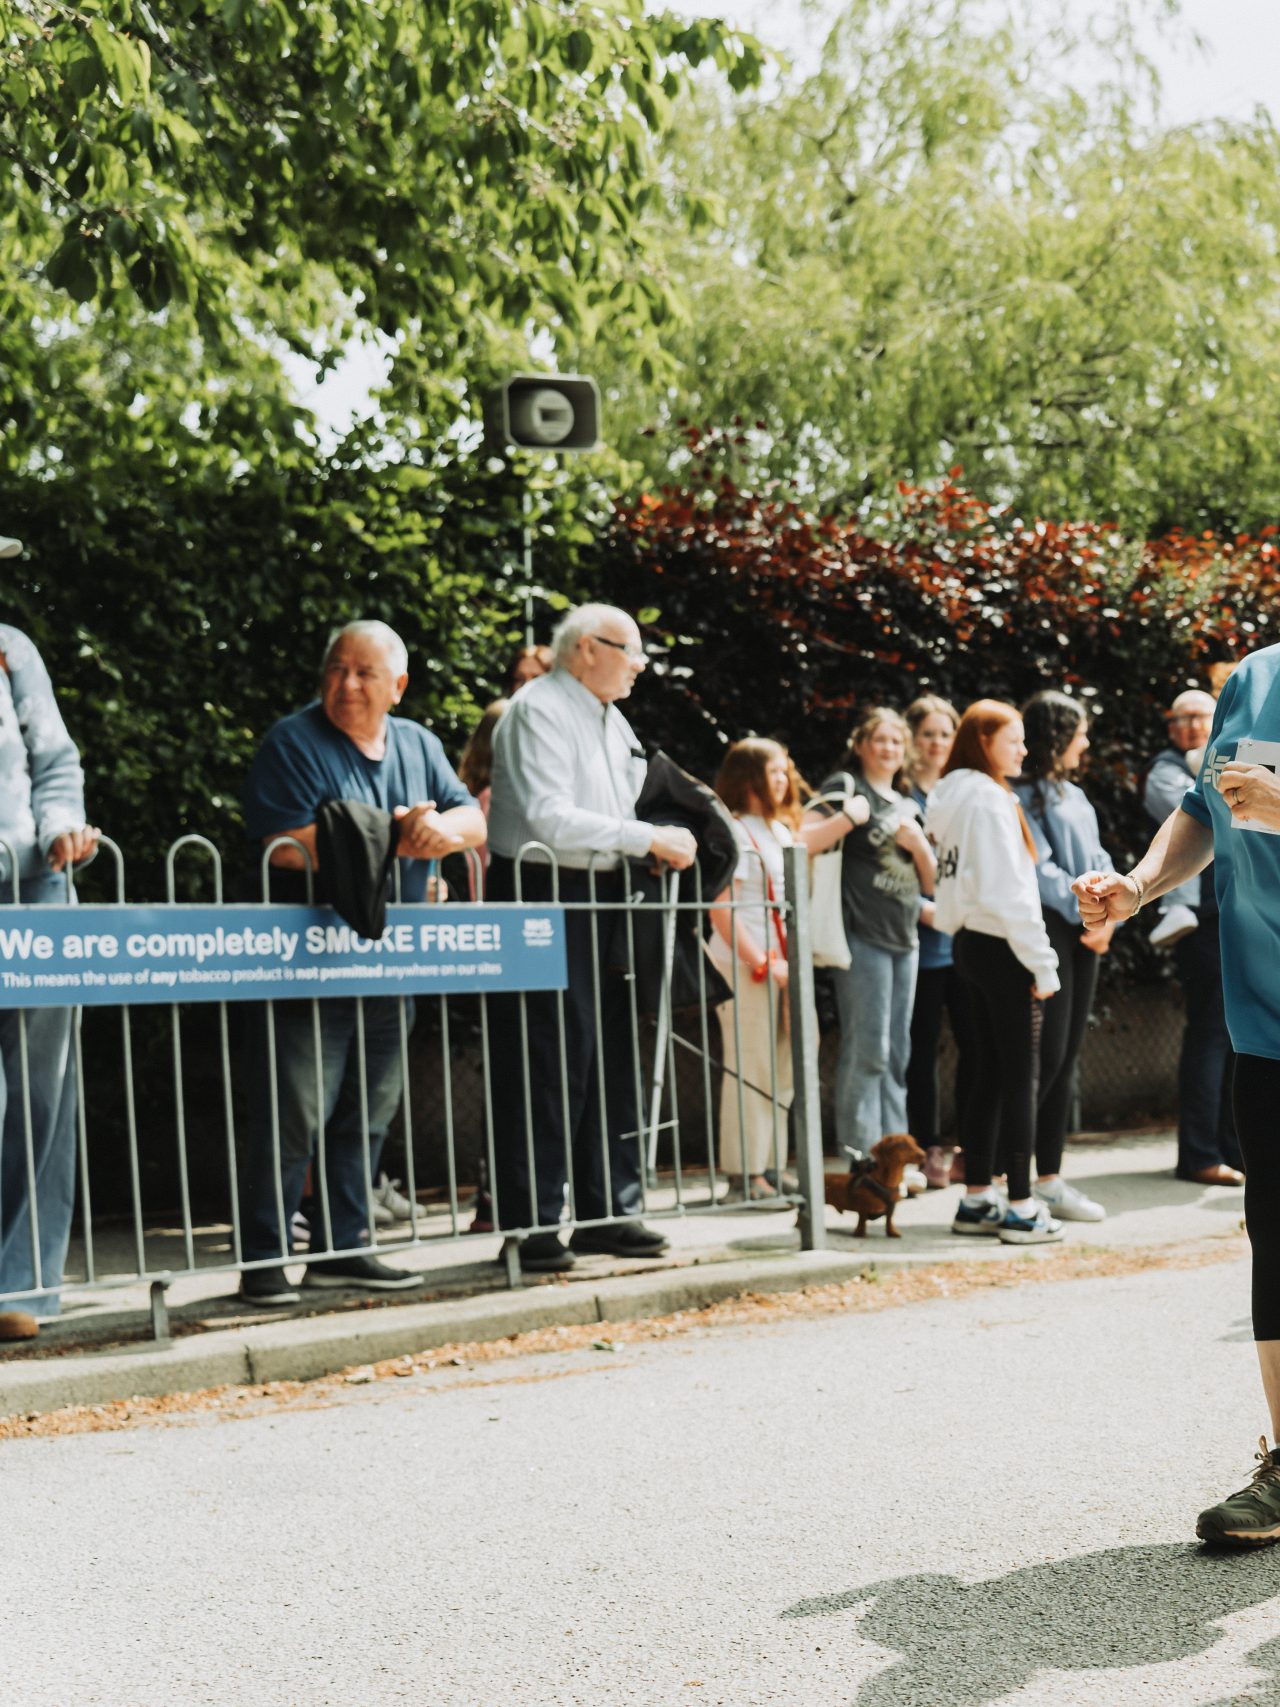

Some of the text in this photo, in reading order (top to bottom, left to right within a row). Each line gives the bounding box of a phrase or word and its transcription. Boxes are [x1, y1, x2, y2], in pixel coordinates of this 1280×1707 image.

[0, 923, 501, 963] We are completely SMOKE FREE!
[2, 962, 502, 988] This means the use of any tobacco product is not permitted anywhere on our sites
